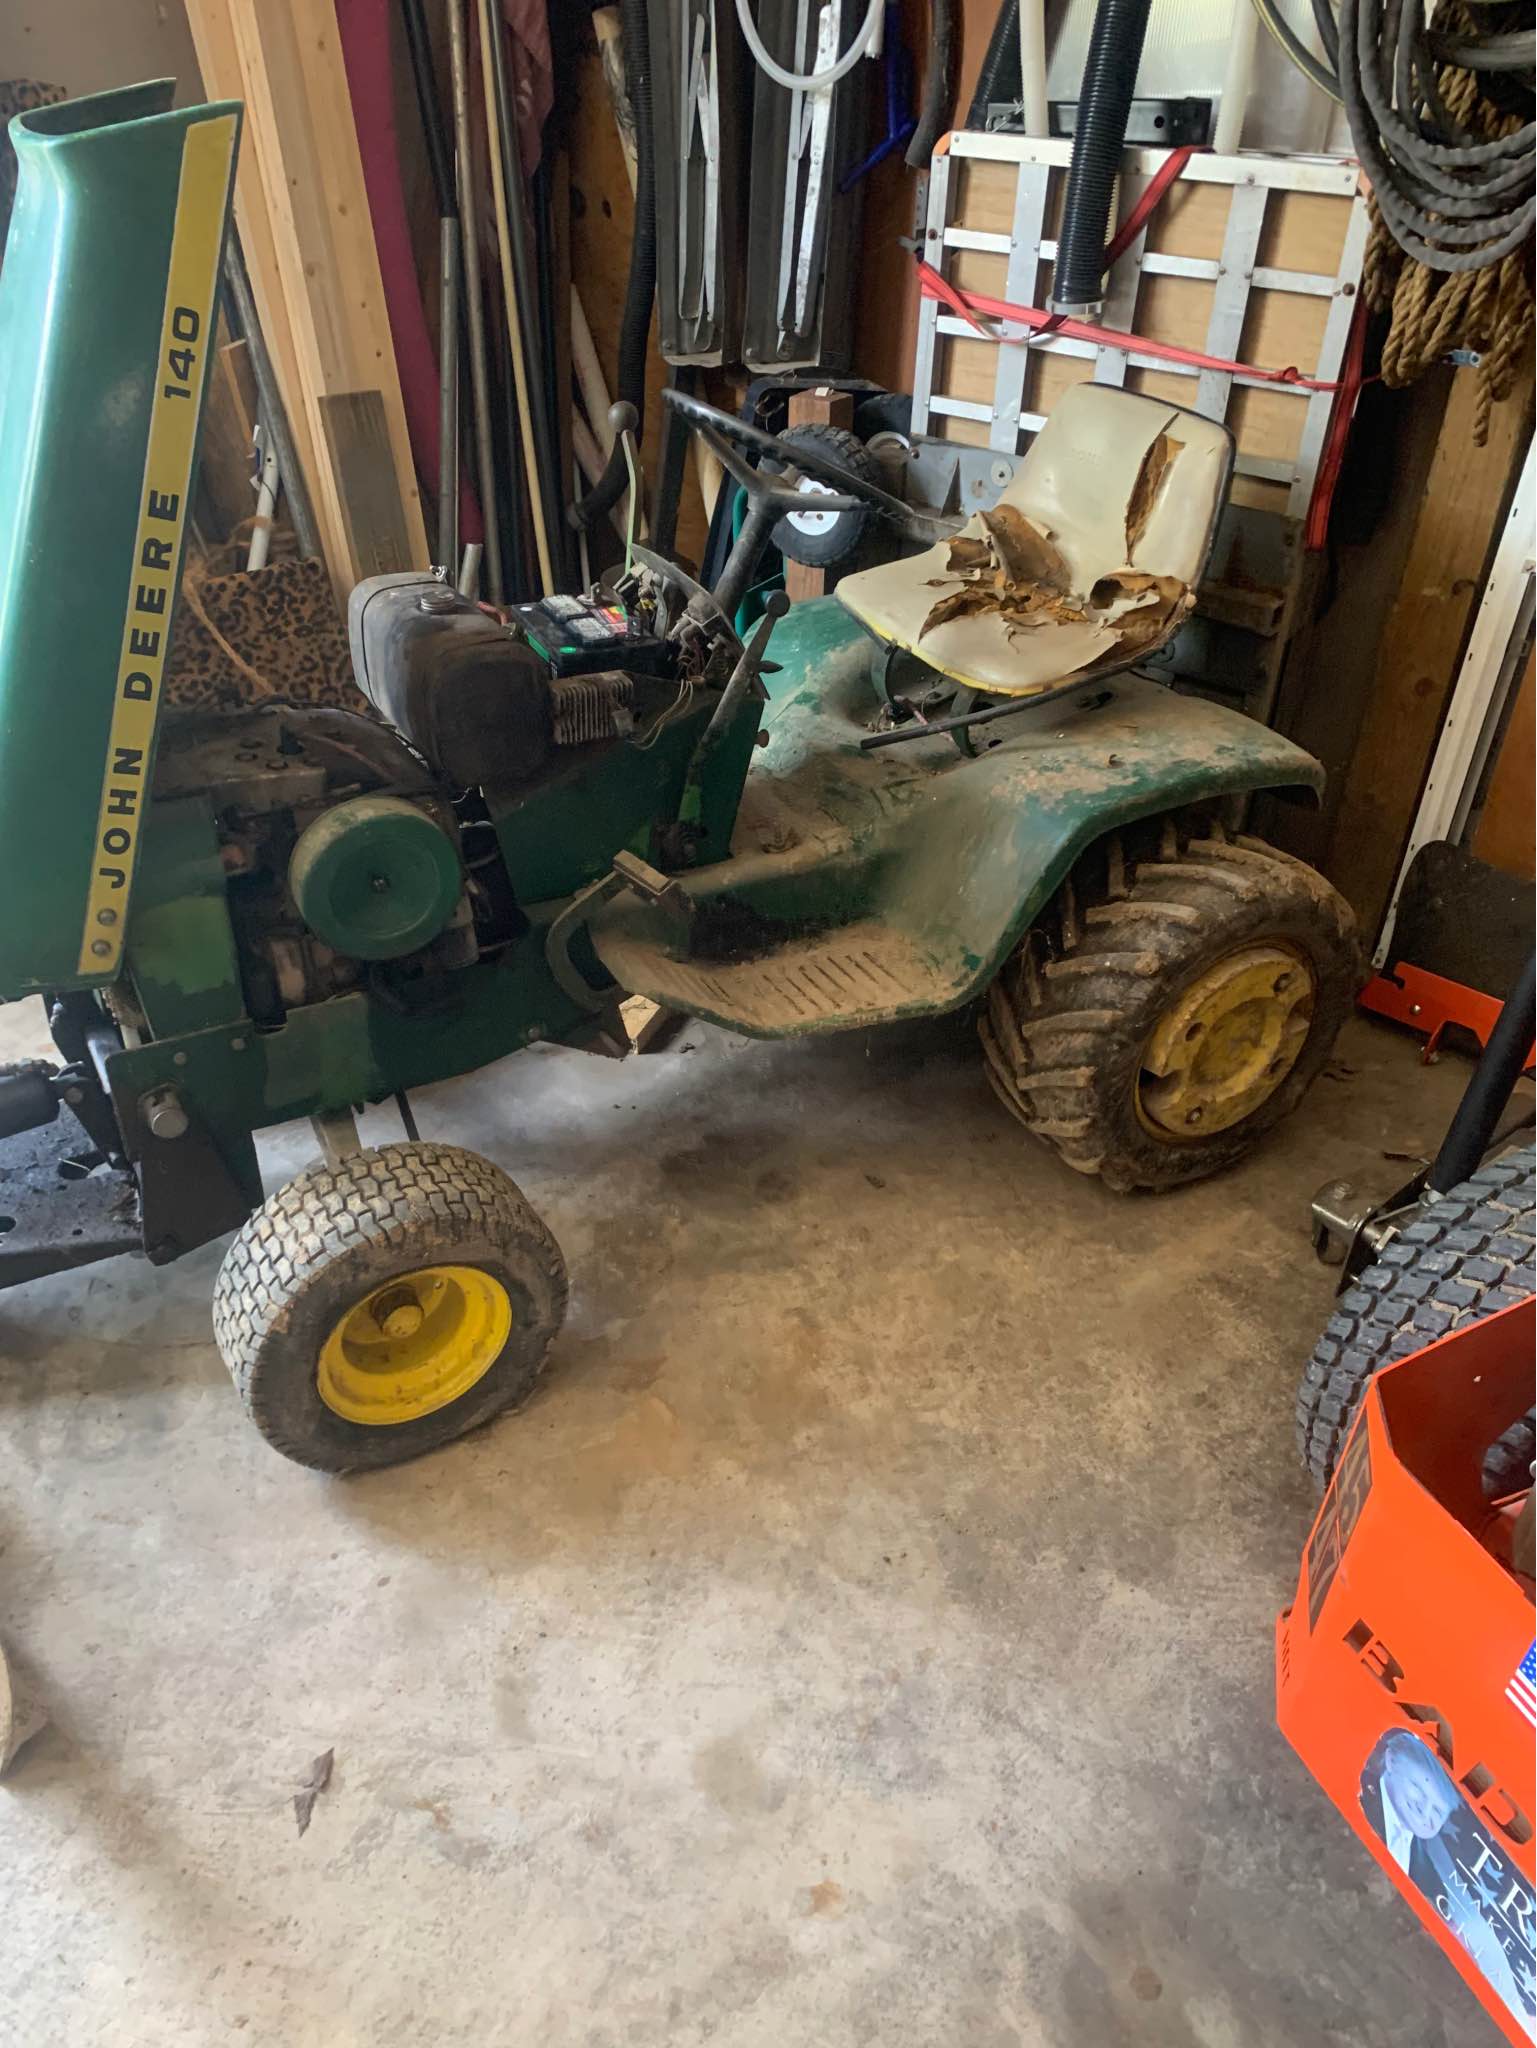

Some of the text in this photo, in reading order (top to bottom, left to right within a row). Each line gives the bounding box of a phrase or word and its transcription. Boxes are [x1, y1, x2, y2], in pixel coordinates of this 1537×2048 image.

[98, 306, 200, 890] JOHN DEERE 140
[1342, 1617, 1534, 1846] BAD
[1448, 1869, 1516, 1956] MAKE
